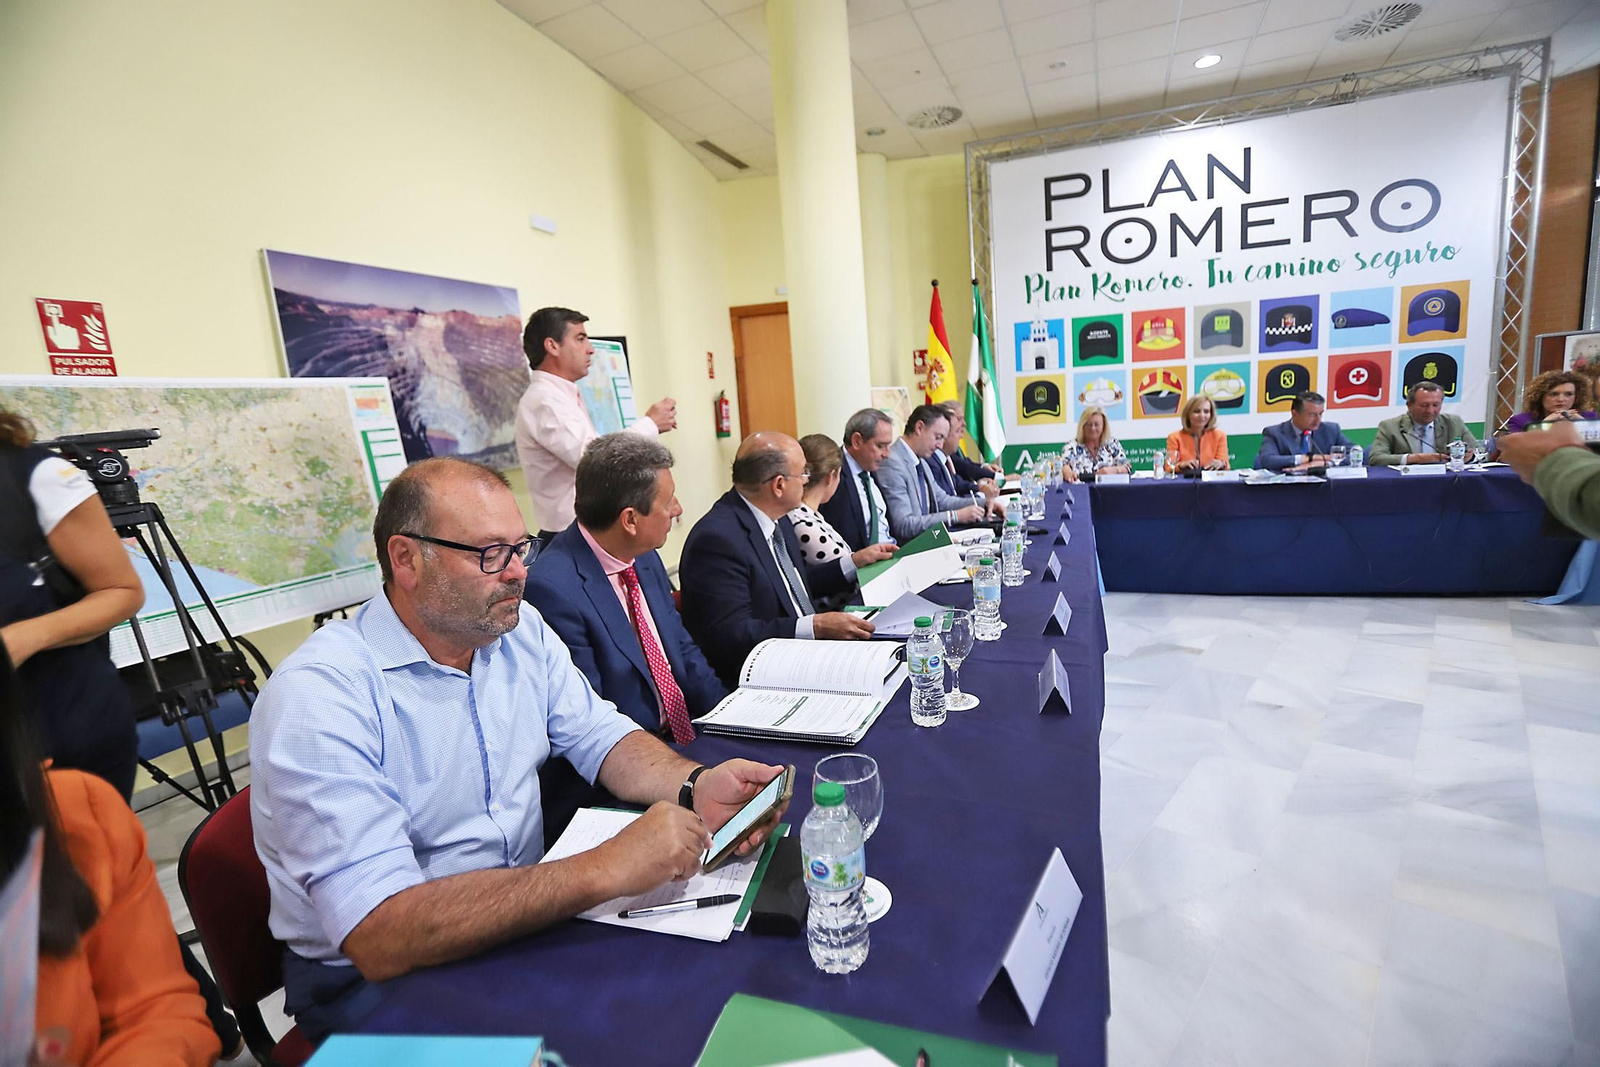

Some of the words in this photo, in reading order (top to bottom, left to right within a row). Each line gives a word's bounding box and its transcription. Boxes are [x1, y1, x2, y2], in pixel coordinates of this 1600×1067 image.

[1044, 146, 1252, 222] PLAN
[1044, 178, 1441, 272] ROMERO
[1023, 273, 1082, 304] Plan
[1091, 271, 1193, 303] Romero.
[1201, 258, 1236, 289] Tu
[1243, 258, 1343, 282] camino
[1352, 241, 1463, 279] seguro
[55, 358, 110, 366] PULSADOR
[55, 367, 71, 375] DE
[72, 367, 115, 375] ALARMA
